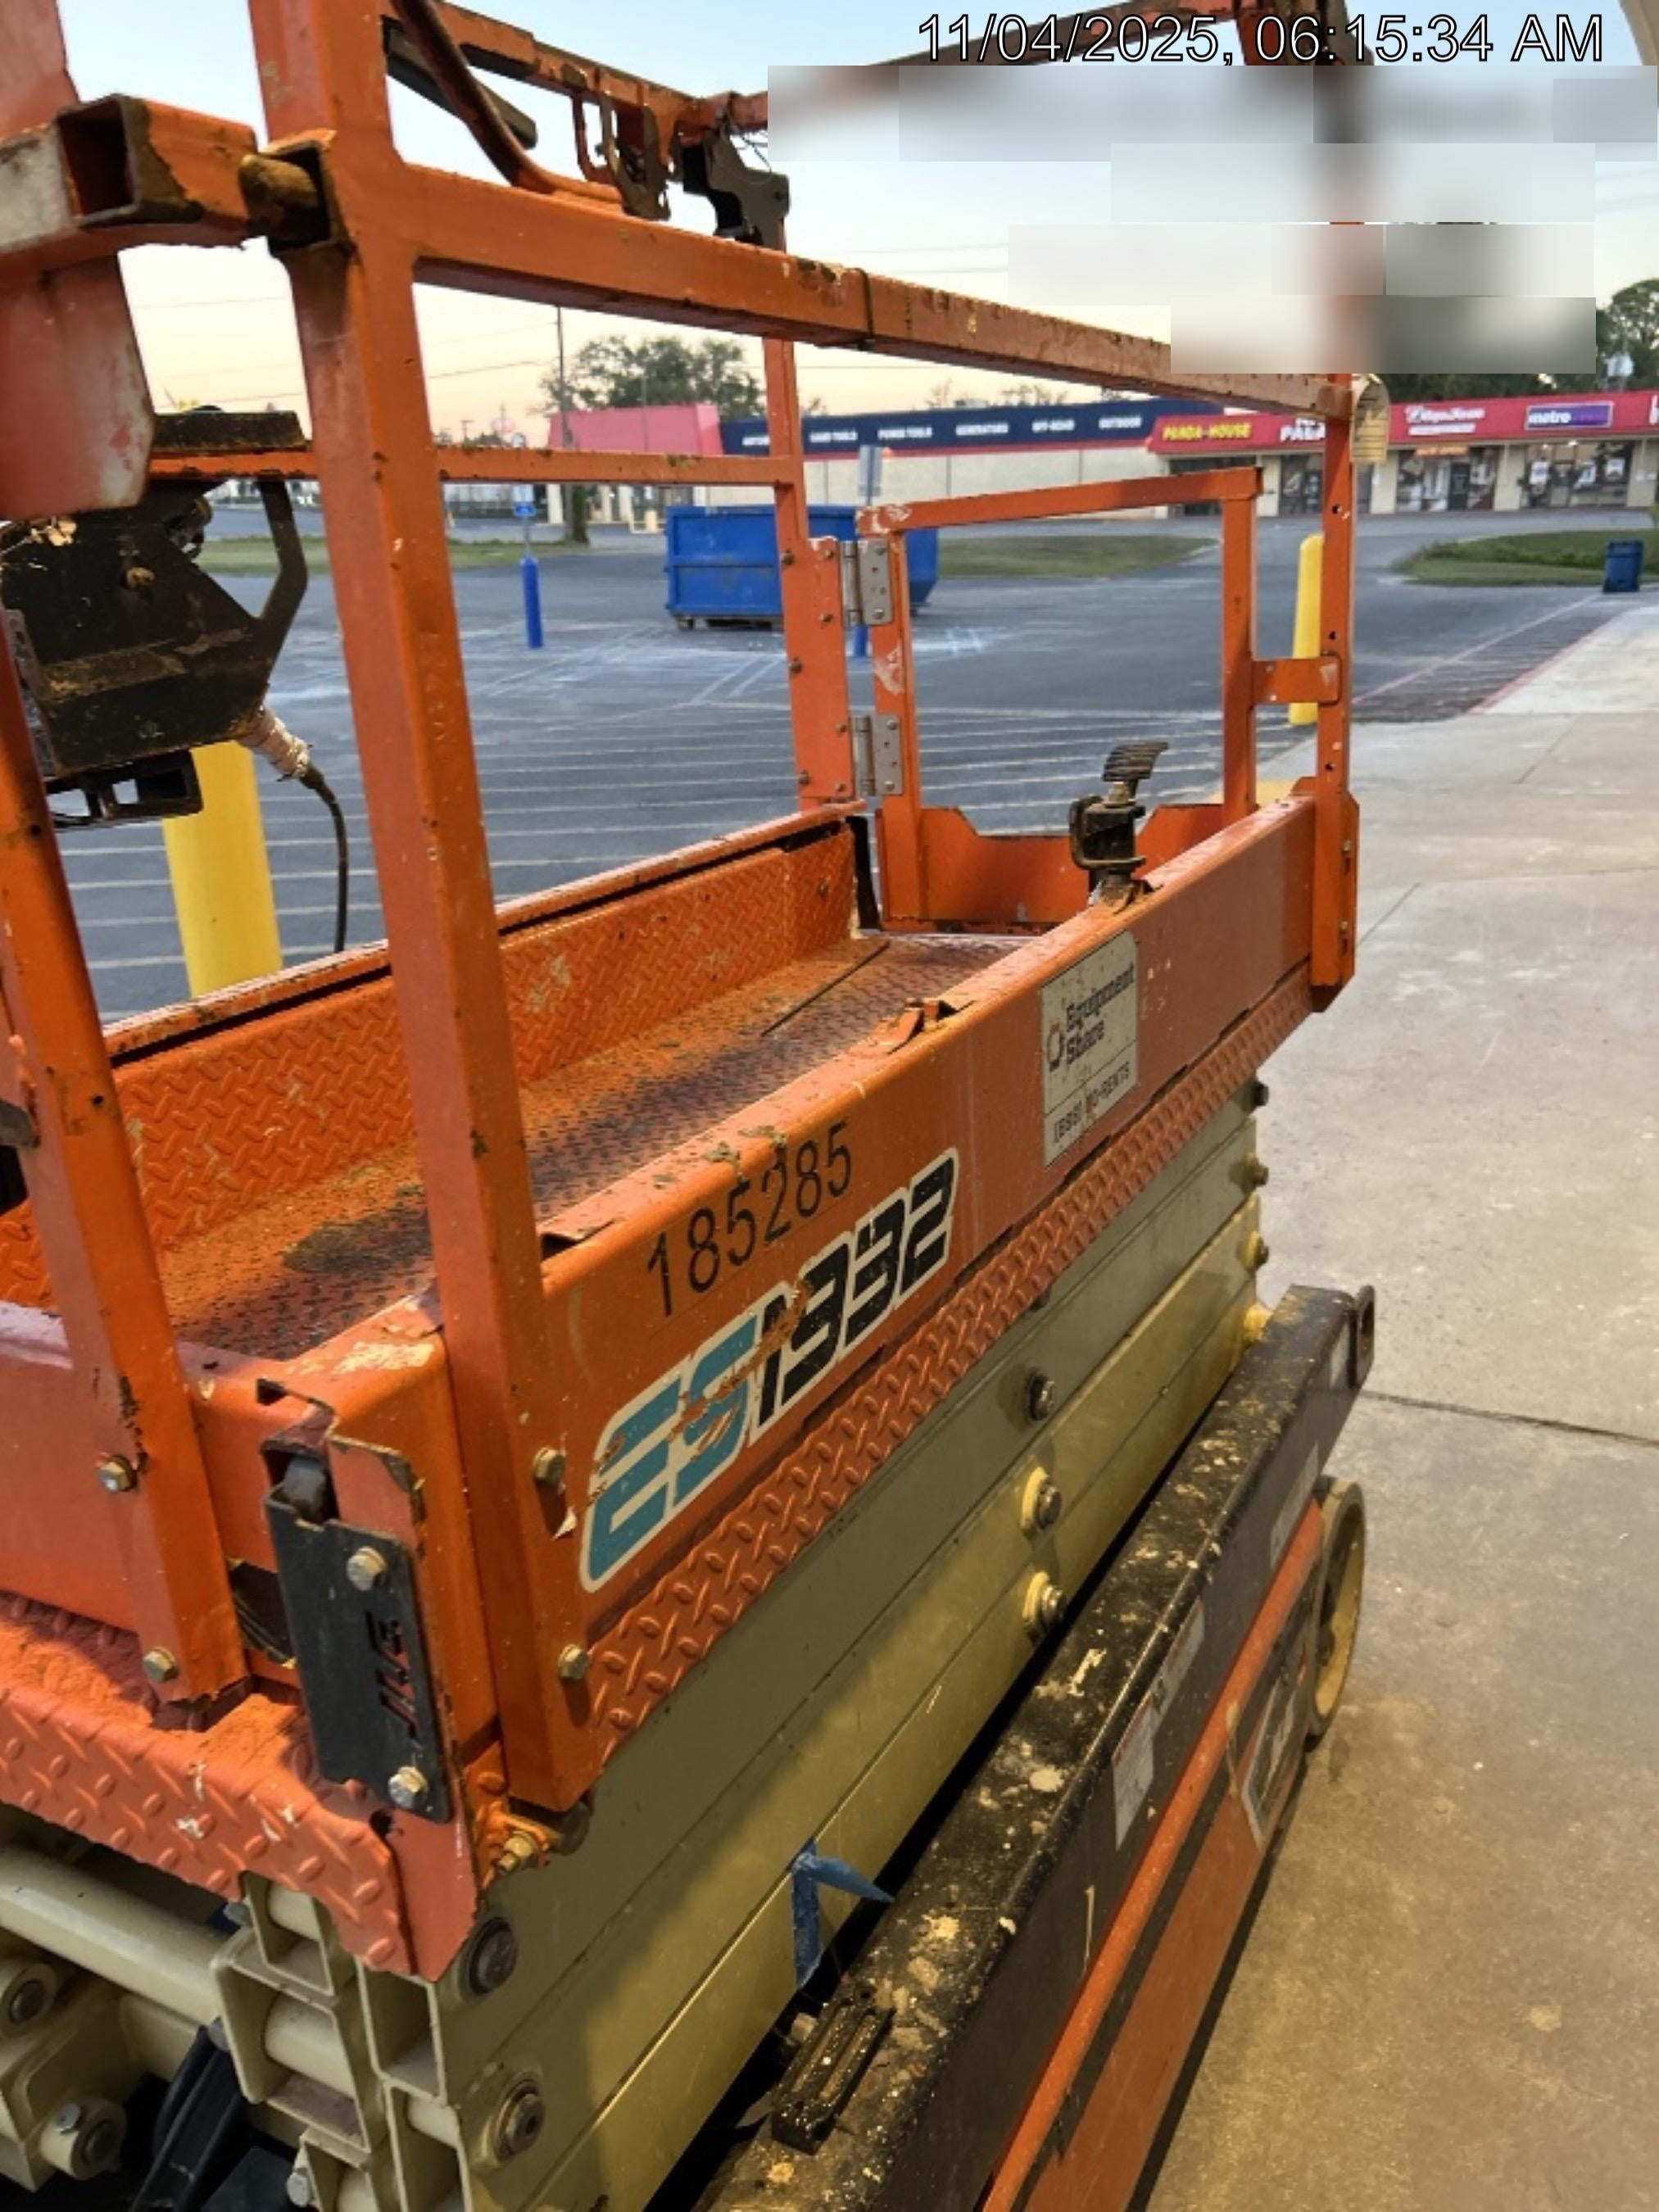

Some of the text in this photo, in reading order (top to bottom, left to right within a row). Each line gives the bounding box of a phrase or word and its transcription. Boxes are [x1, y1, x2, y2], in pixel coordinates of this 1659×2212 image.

[1529, 410, 1572, 424] metro
[1067, 962, 1134, 1033] Equipment
[1067, 1019, 1104, 1065] Share
[647, 1121, 851, 1316] 185285
[580, 1149, 959, 1591] ES1932
